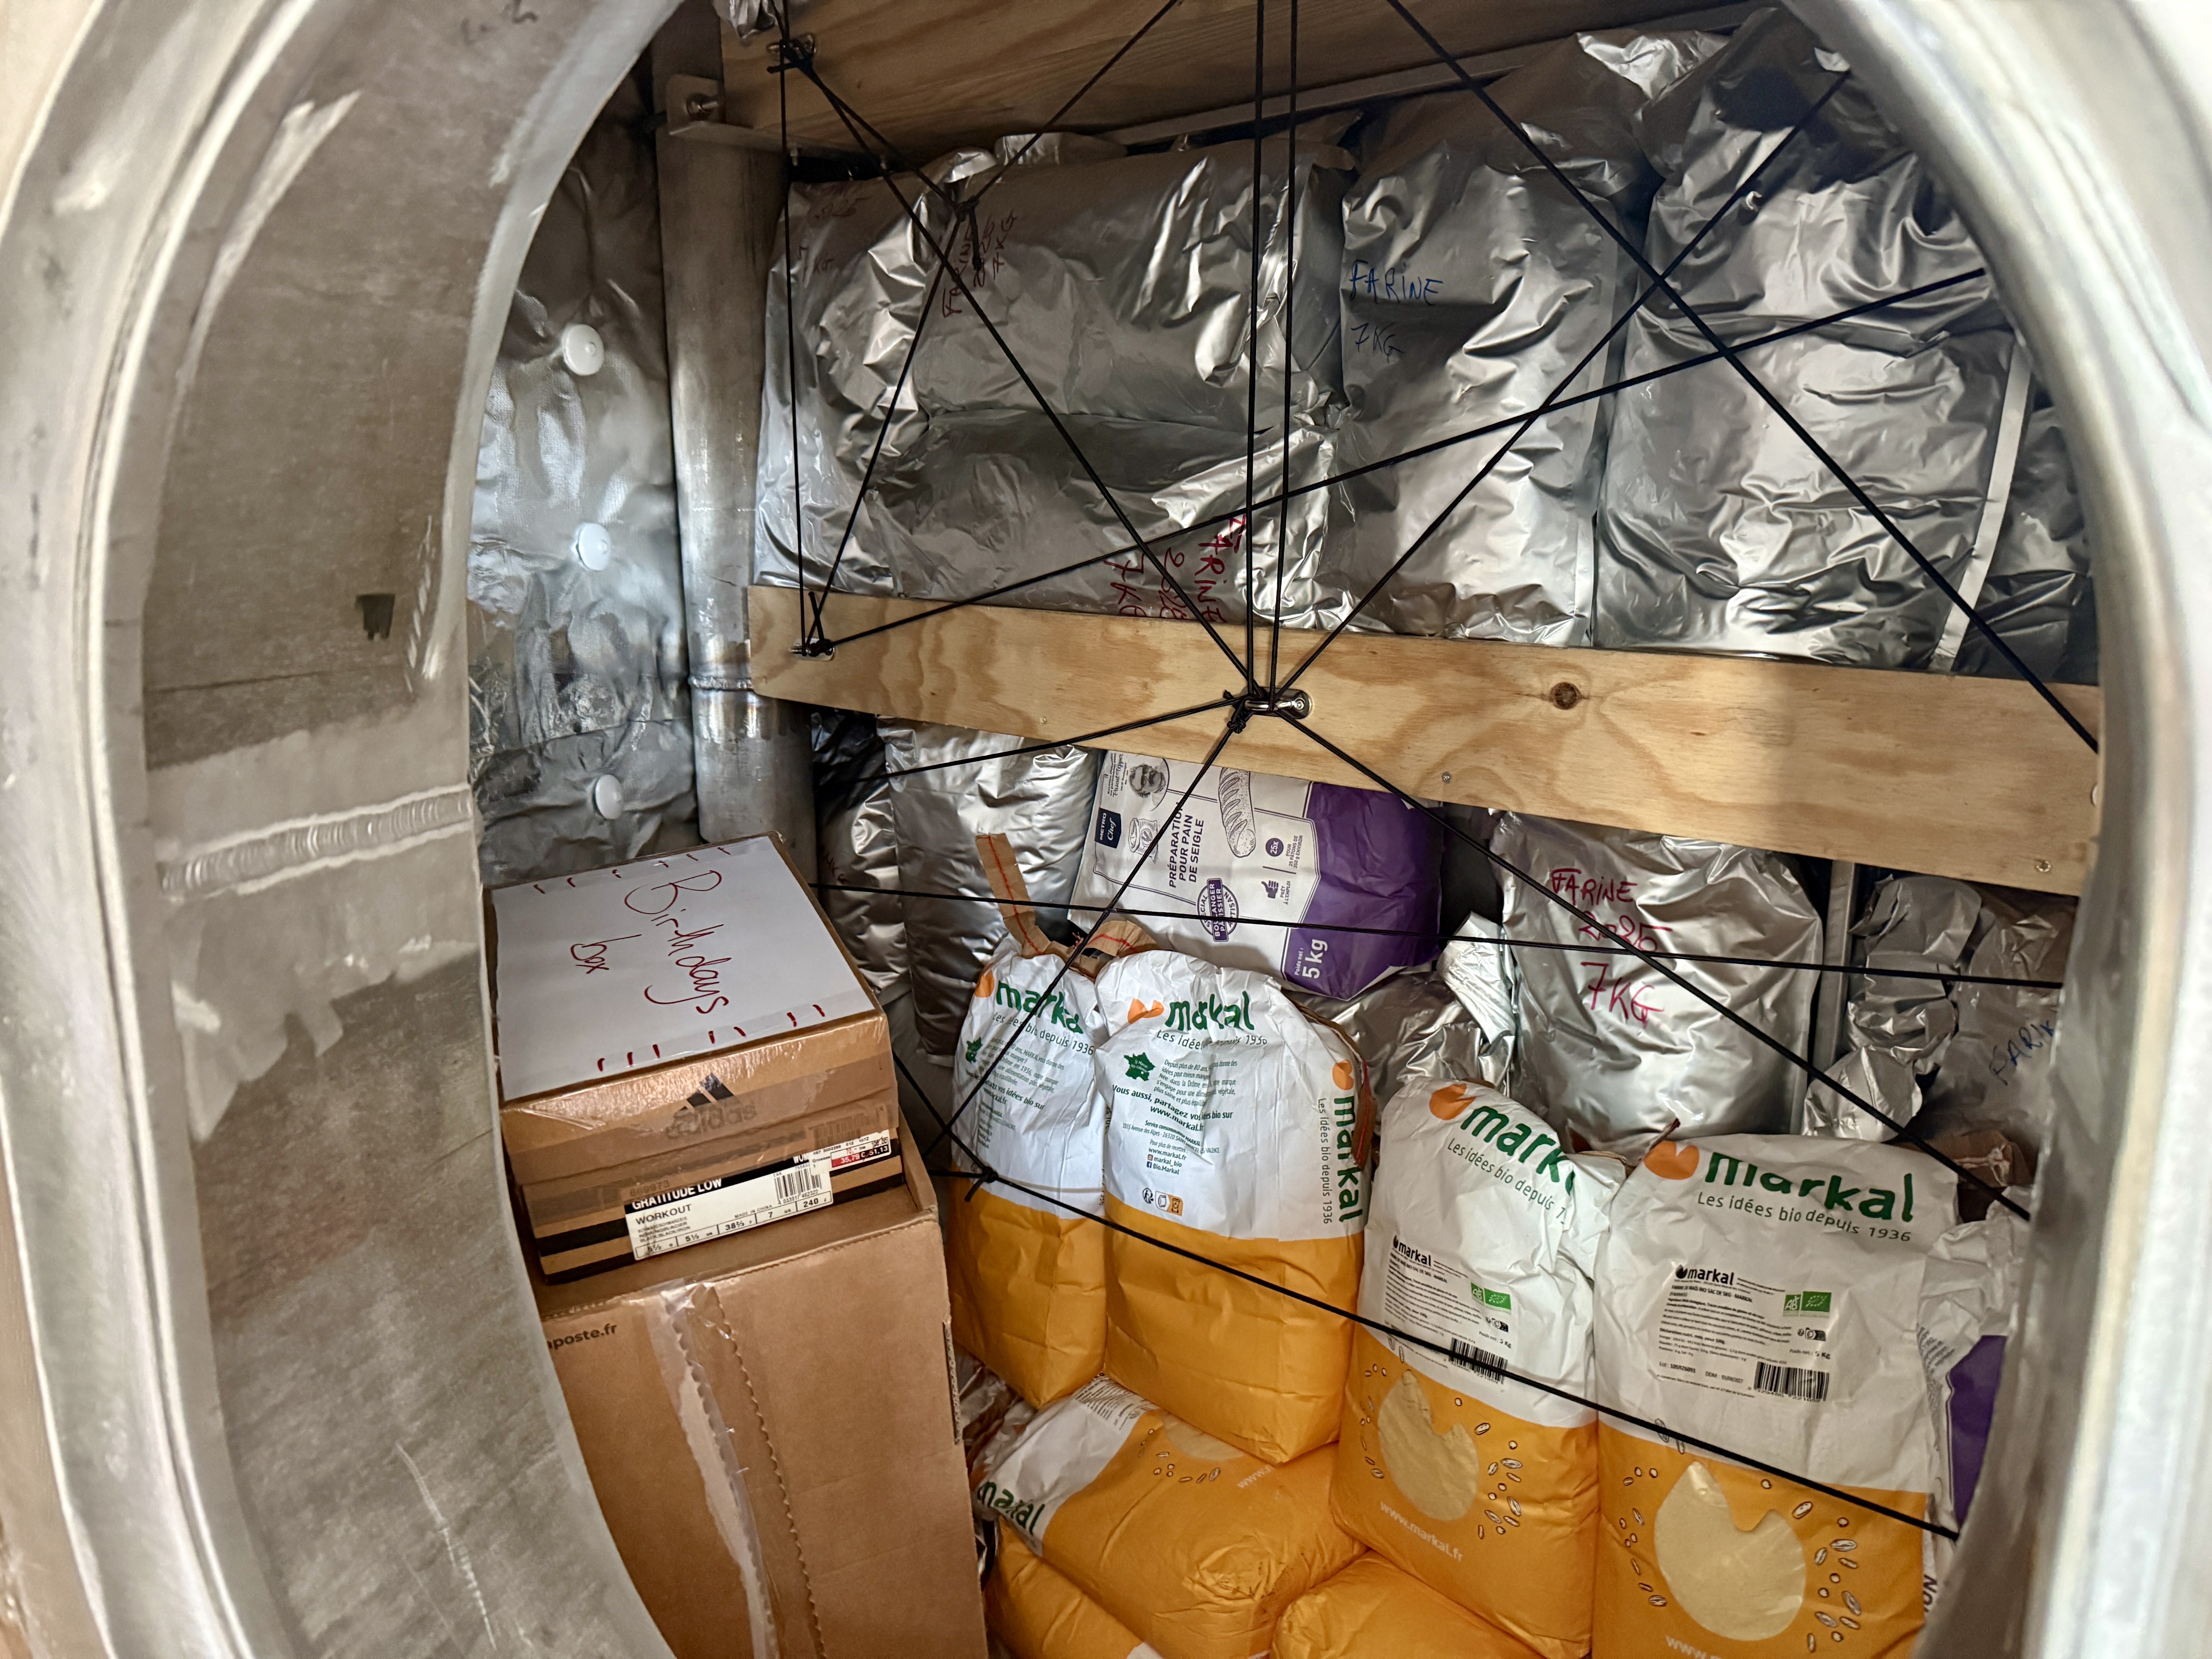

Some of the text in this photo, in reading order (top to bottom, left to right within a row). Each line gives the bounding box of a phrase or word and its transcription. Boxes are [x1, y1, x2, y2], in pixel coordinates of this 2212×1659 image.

[1349, 260, 1443, 305] FARINE
[1107, 817, 1116, 841] Chef
[1179, 814, 1193, 881] POUR PAIN
[1188, 818, 1204, 883] DE SEIGLE
[1269, 840, 1279, 855] 25x
[1552, 869, 1637, 905] FARINE
[570, 934, 642, 974] box
[1302, 939, 1328, 979] 5 kg
[1040, 1029, 1069, 1047] depuis
[1072, 1040, 1094, 1056] 1936
[1156, 1030, 1175, 1042] Les
[1164, 1059, 1178, 1068] Depuis
[1006, 1088, 1024, 1101] idées
[1024, 1096, 1034, 1106] bio
[1034, 1101, 1046, 1110] sur
[1113, 1084, 1130, 1095] Vous
[1131, 1089, 1152, 1102] aussi,
[1154, 1096, 1188, 1118] partagez
[1212, 1111, 1221, 1119] bio
[1222, 1111, 1233, 1119] sur
[1318, 1098, 1327, 1114] Les
[1319, 1116, 1331, 1144] idées
[1321, 1164, 1332, 1197] depuis
[1447, 1137, 1555, 1210] Les idées bio depuis
[1705, 1152, 1913, 1222] markal
[632, 1178, 722, 1210] GRATITUDE LOW
[803, 1198, 819, 1208] 240
[635, 1204, 692, 1225] WORKOUT
[1323, 1200, 1333, 1224] 1936
[1698, 1191, 1911, 1242] Les idées bio depuis 1936
[1398, 1242, 1432, 1267] markal
[1688, 1268, 1734, 1286] markal
[1380, 1501, 1463, 1562] www.markal.fr
